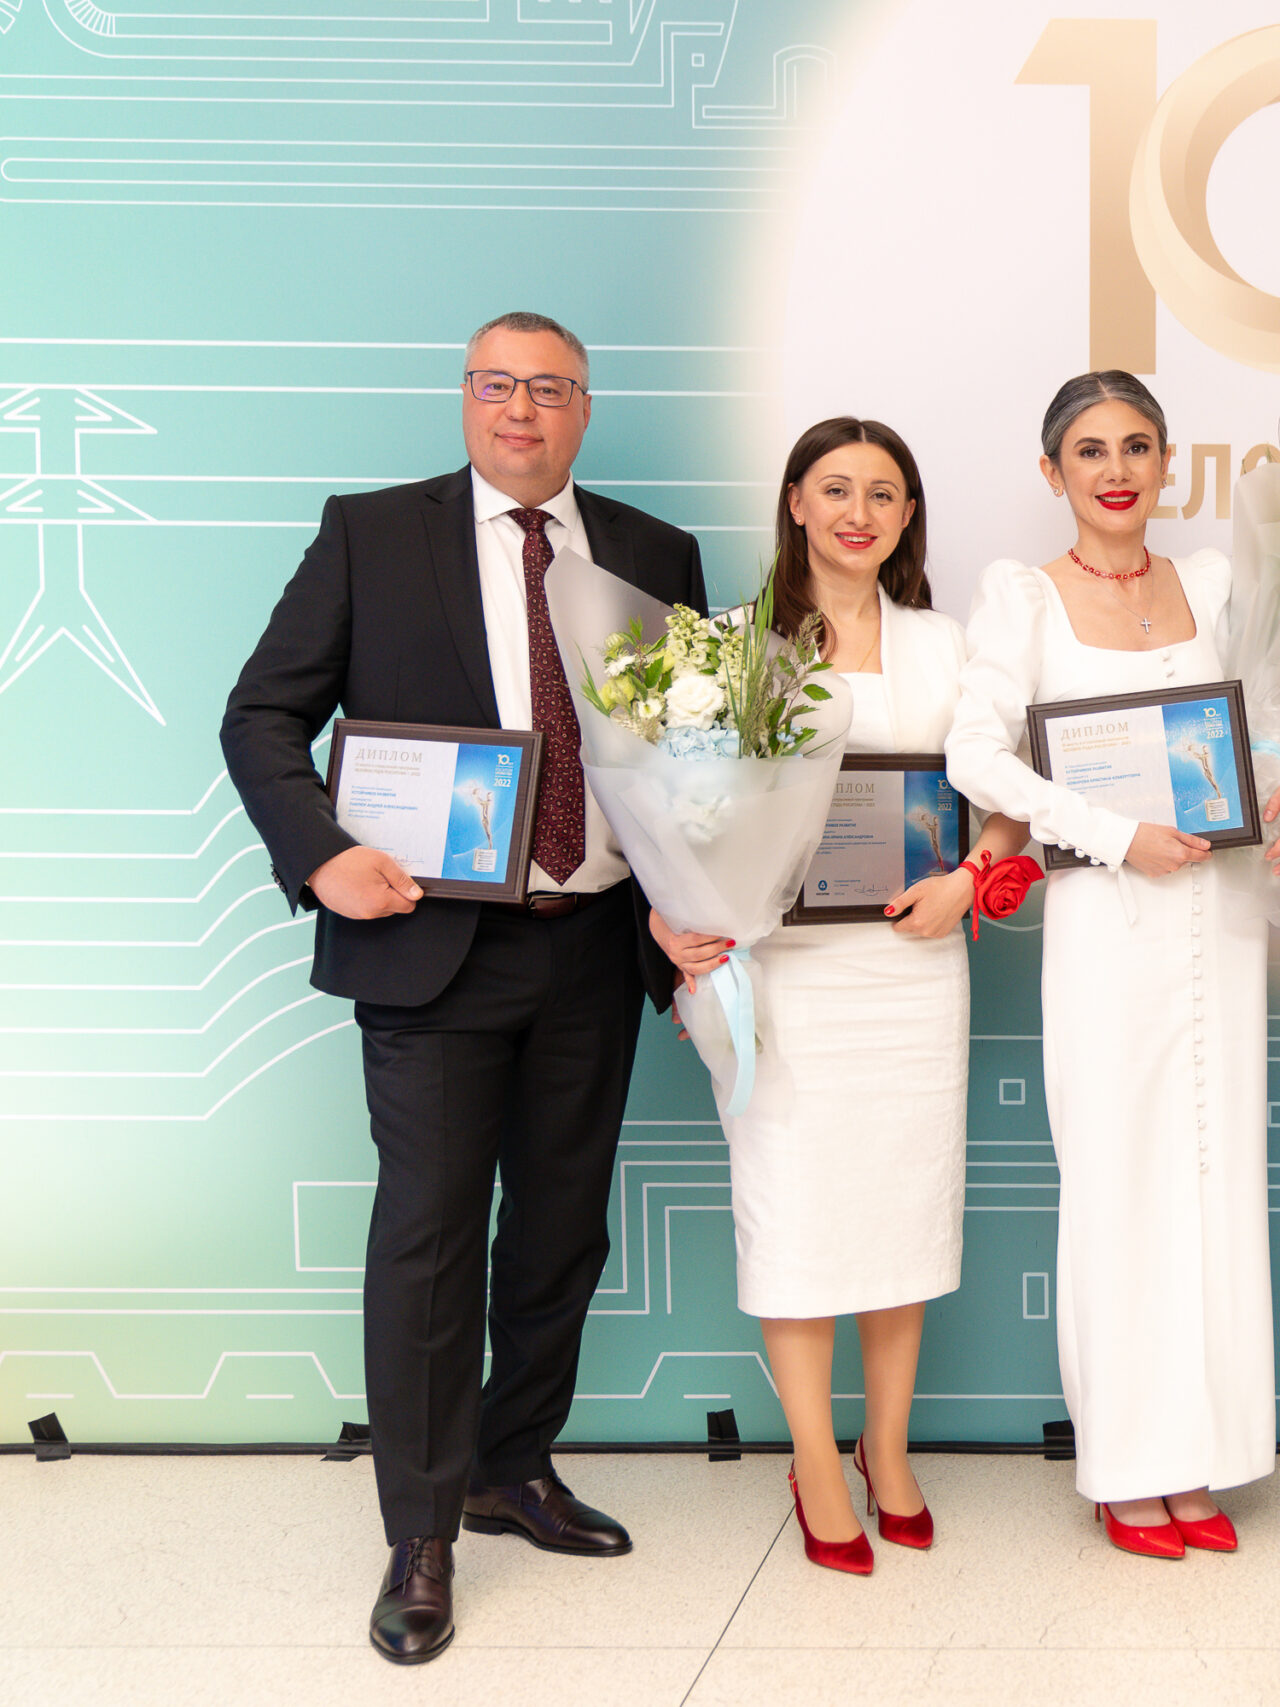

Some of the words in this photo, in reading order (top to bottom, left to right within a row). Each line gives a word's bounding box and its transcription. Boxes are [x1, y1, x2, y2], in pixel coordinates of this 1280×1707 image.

[1060, 721, 1129, 741] ДИПЛОМ
[1207, 729, 1225, 740] 2022
[355, 749, 423, 763] ДИПЛОМ
[493, 778, 511, 788] 2022
[836, 783, 875, 794] ПЛОМ
[937, 803, 953, 811] 2022
